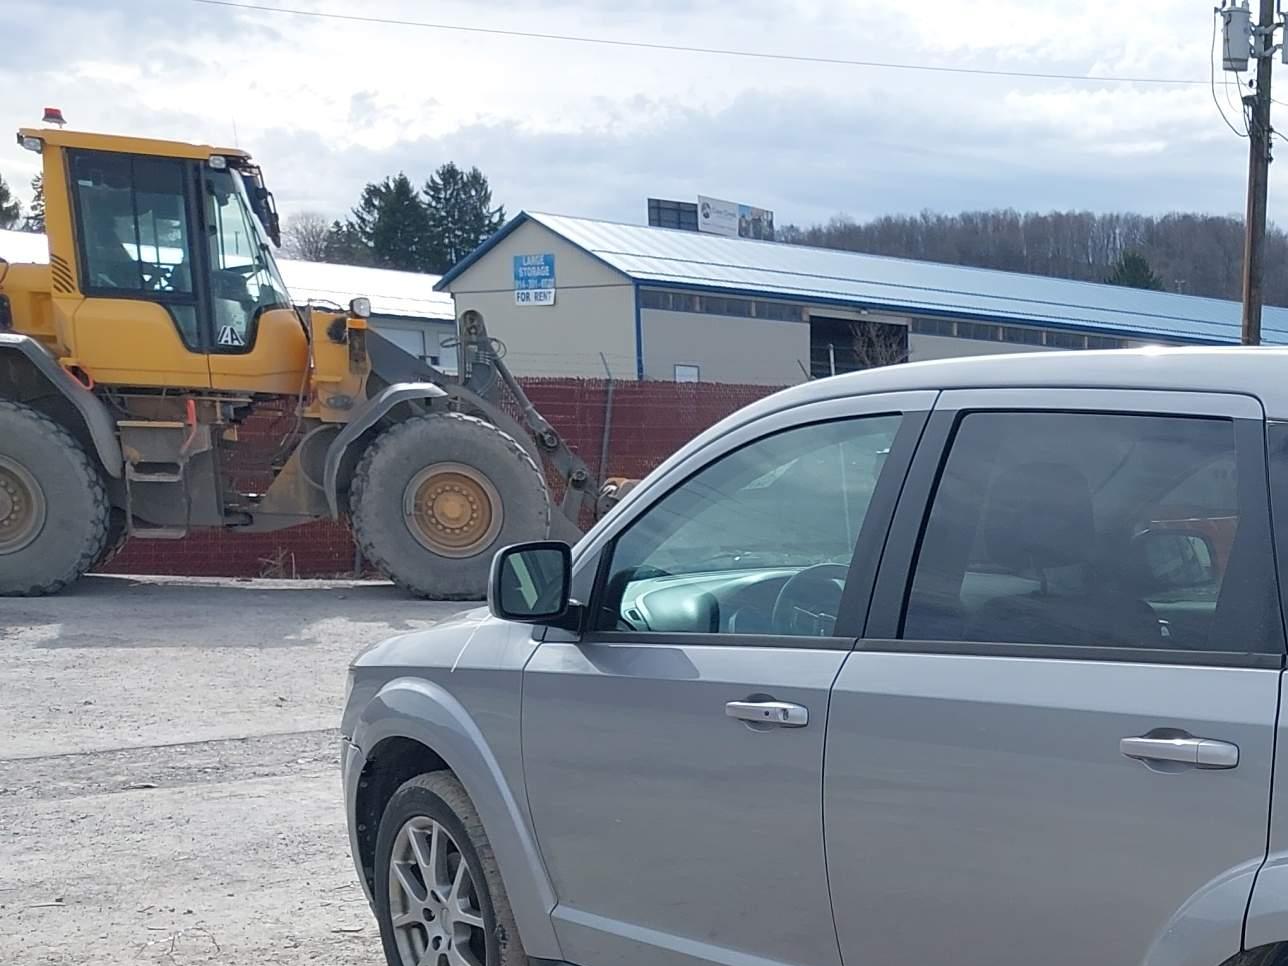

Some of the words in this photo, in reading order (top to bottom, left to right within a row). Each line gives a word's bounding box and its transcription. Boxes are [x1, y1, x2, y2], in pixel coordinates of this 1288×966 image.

[519, 265, 550, 277] STORAGE
[516, 291, 531, 302] FOR
[534, 290, 552, 302] RENT
